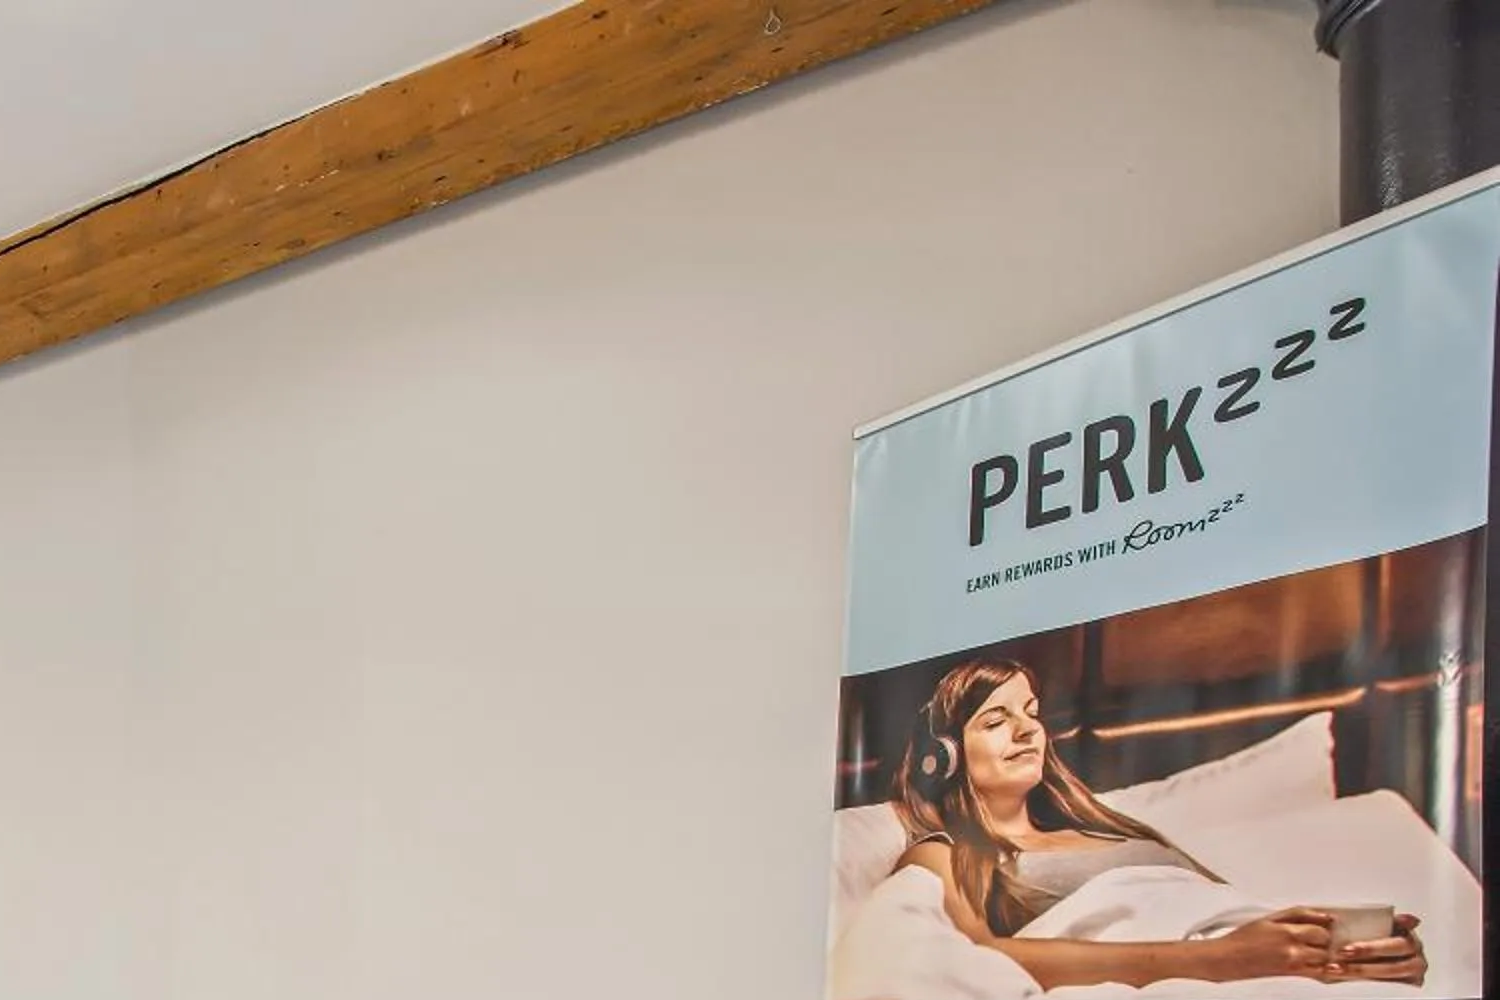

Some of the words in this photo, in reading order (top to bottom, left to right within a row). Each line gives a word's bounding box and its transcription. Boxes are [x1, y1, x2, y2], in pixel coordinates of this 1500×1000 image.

[966, 571, 1000, 593] EARN
[1004, 552, 1073, 583] REWARDS
[1078, 540, 1116, 564] WITH
